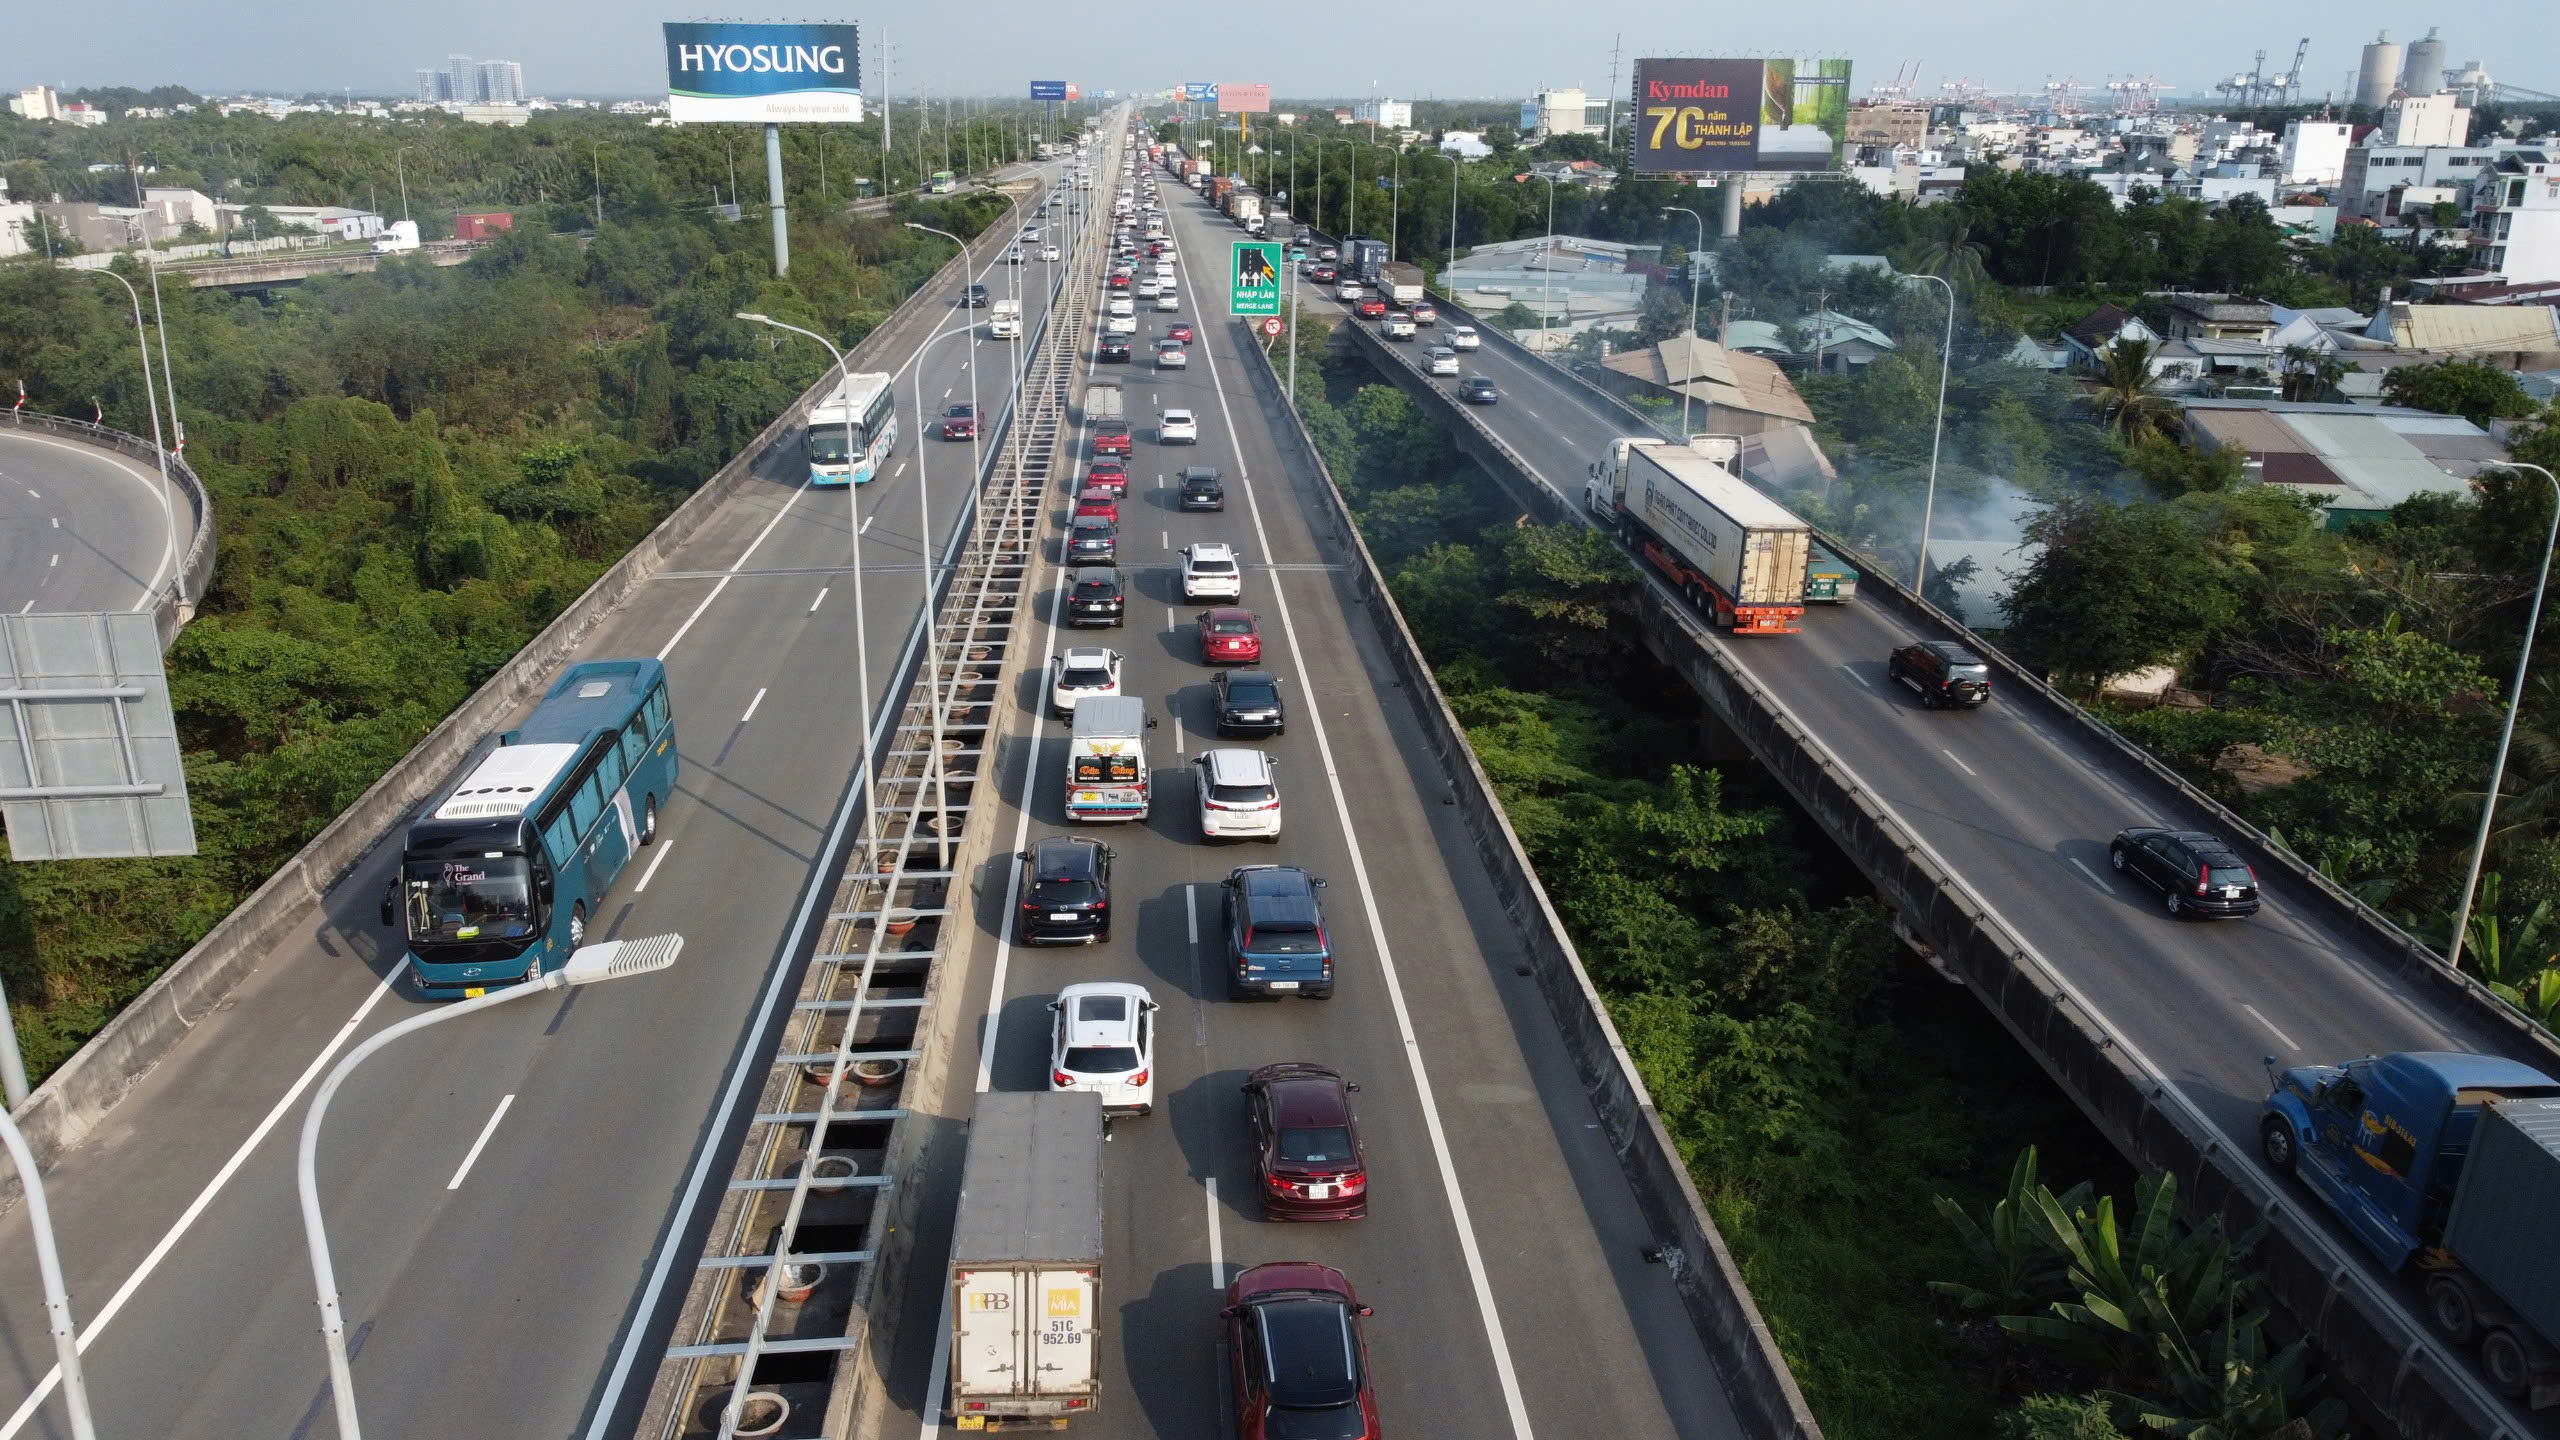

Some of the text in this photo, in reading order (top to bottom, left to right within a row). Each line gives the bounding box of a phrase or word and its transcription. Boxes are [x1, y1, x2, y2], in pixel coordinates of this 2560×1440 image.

[679, 44, 845, 73] HYOSUNG
[1648, 79, 1729, 102] Kymdan
[766, 103, 850, 115] Always by your side
[1707, 111, 1727, 121] năm
[1694, 121, 1753, 140] THÀNH LẬP
[1236, 289, 1274, 300] NHẬP LÀN
[454, 864, 469, 872] The
[455, 871, 485, 881] Grand
[1052, 1320, 1073, 1332] 51C
[1043, 1333, 1081, 1345] 952.69
